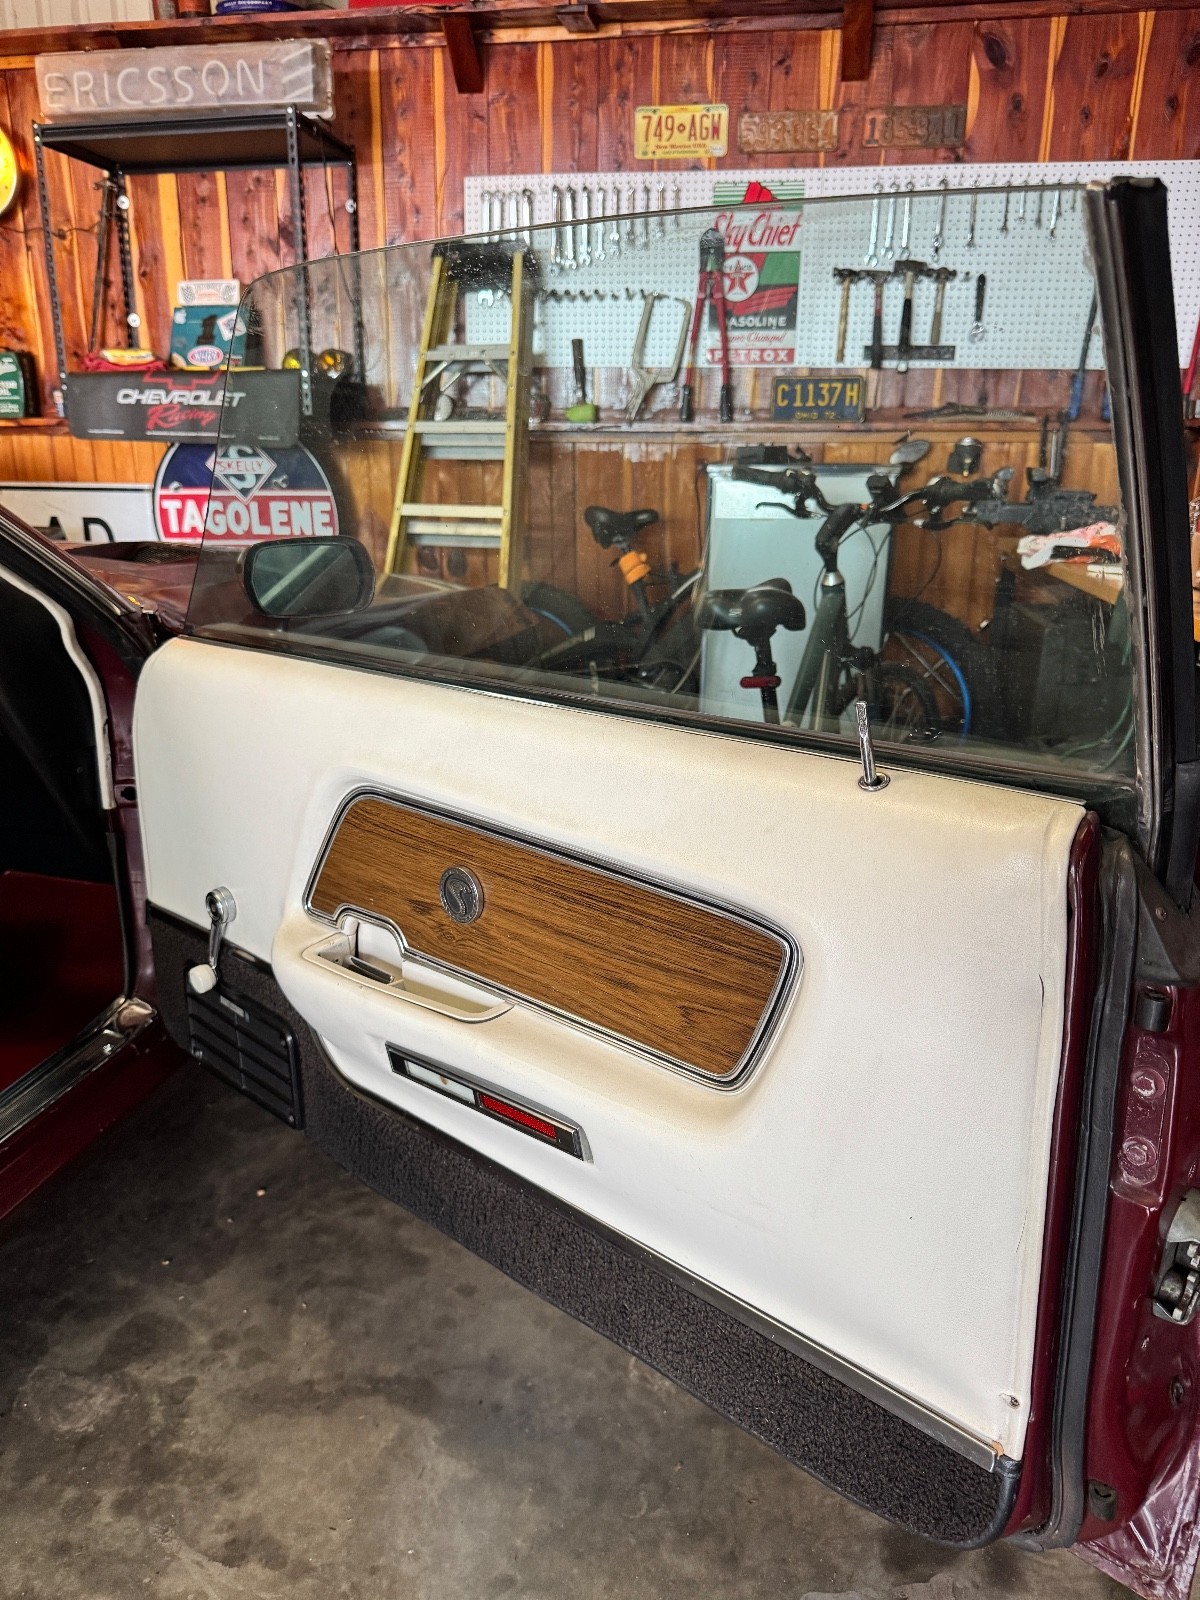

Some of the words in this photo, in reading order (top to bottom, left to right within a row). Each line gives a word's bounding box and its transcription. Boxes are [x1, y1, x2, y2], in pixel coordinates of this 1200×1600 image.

[44, 59, 265, 108] ERICSSON
[642, 115, 675, 143] 749
[748, 211, 804, 246] Chief
[727, 315, 787, 328] ASOLINE
[117, 387, 247, 408] CHEVROLET
[777, 383, 859, 407] C1137H
[147, 403, 218, 430] Racing
[216, 460, 264, 473] SKELLY
[161, 499, 334, 536] TAGOLENE
